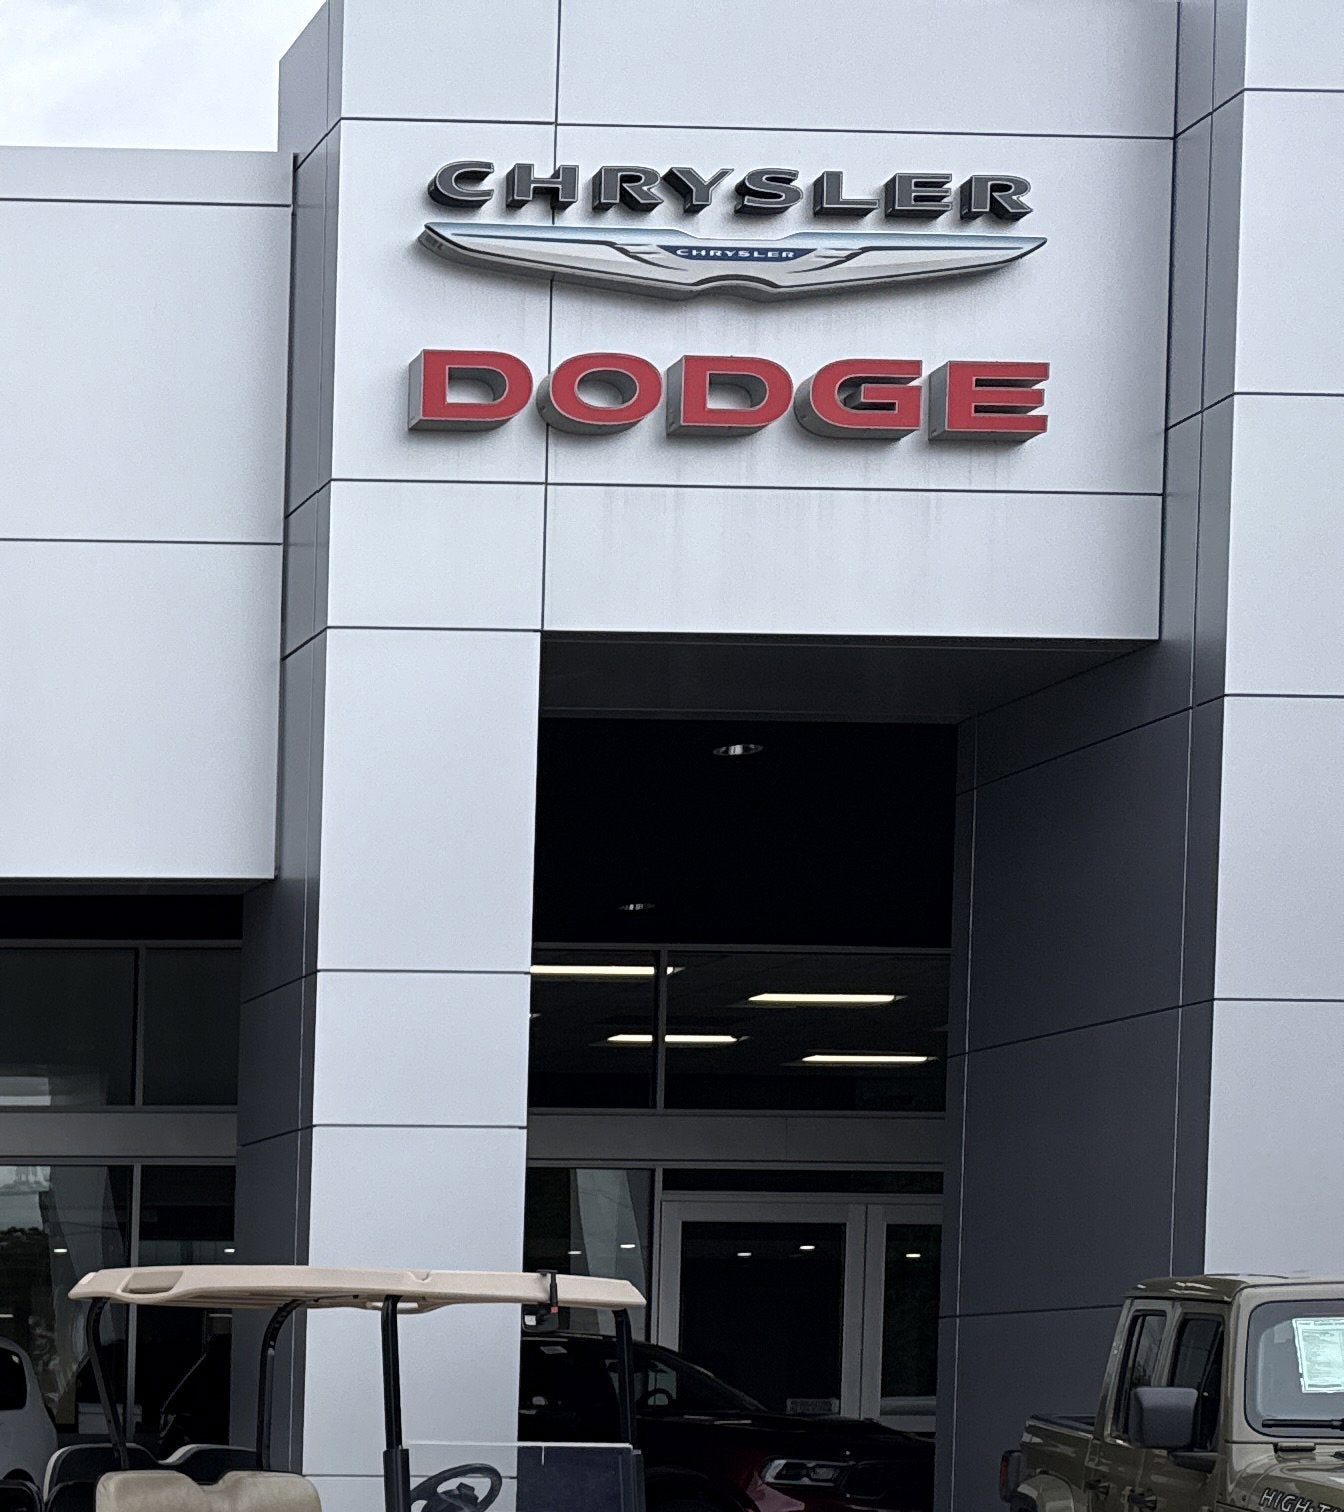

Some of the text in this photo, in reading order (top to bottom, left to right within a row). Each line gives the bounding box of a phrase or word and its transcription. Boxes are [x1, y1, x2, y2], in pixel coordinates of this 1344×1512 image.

[427, 160, 1033, 220] CHRYSLER
[676, 248, 795, 258] CHRYSLER
[409, 348, 1050, 440] DODGE
